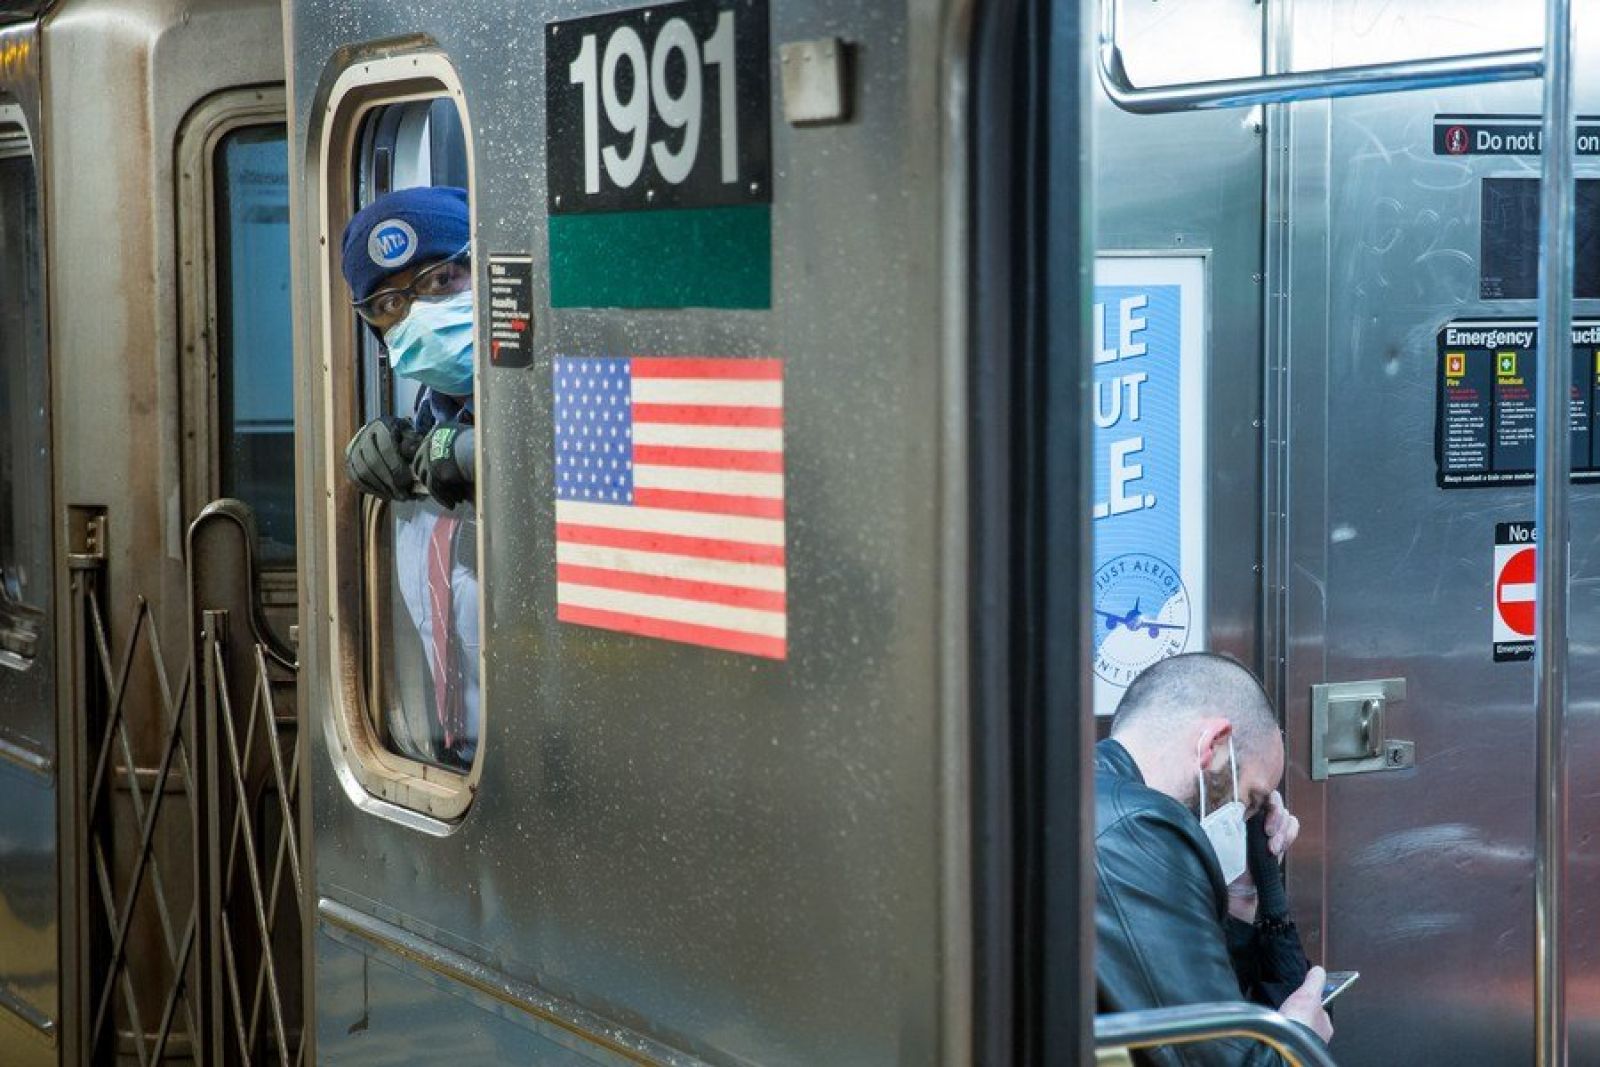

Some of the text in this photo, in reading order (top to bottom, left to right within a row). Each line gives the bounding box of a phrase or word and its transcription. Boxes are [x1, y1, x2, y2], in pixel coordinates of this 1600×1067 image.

[569, 10, 739, 195] 1991
[1476, 130, 1502, 150] Do
[1506, 130, 1535, 150] not
[1577, 135, 1600, 150] on
[376, 233, 406, 256] MTA
[1446, 329, 1533, 348] Emergency
[1508, 525, 1529, 541] No
